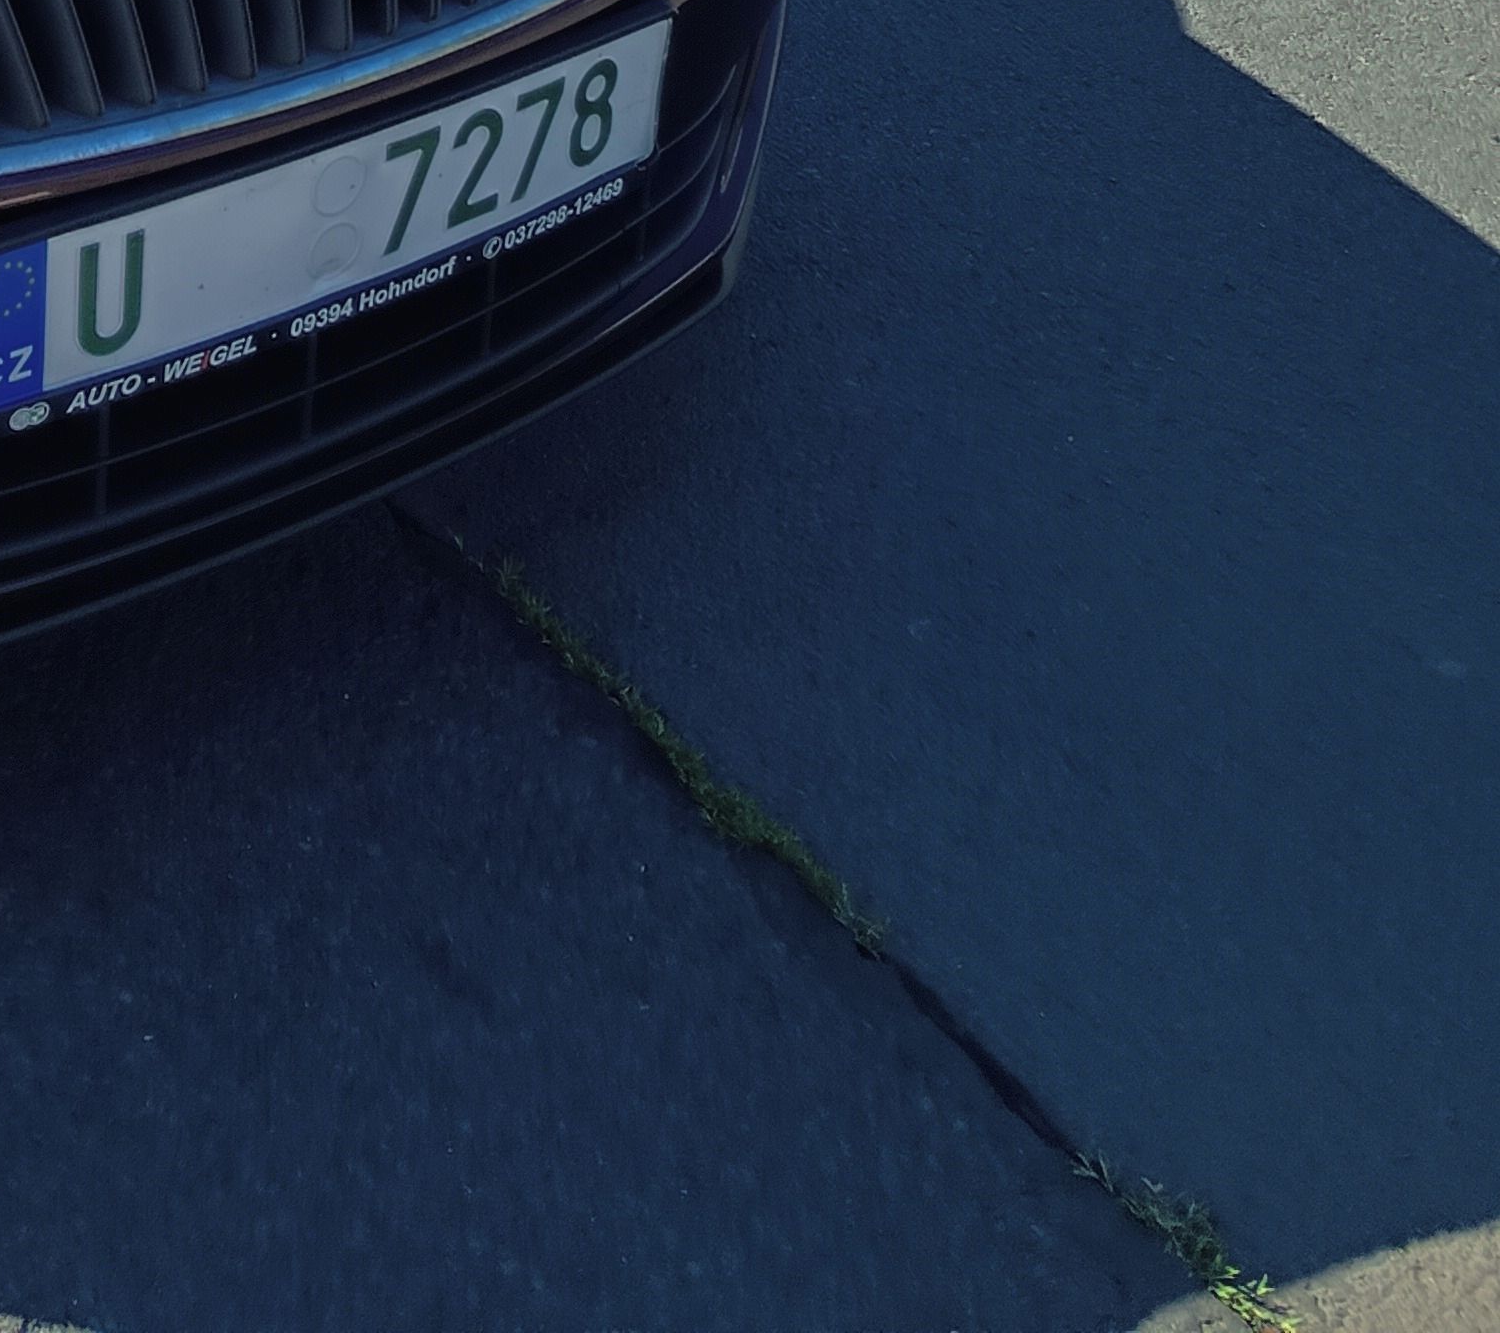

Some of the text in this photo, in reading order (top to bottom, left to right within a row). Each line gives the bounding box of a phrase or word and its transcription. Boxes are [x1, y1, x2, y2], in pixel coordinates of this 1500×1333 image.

[66, 374, 141, 414] AUTO
[162, 335, 257, 383] WEIGEL
[290, 298, 354, 337] 09394
[358, 255, 457, 312] Hohndorf
[504, 177, 624, 250] 037298-12469
[75, 58, 619, 357] U 7278
